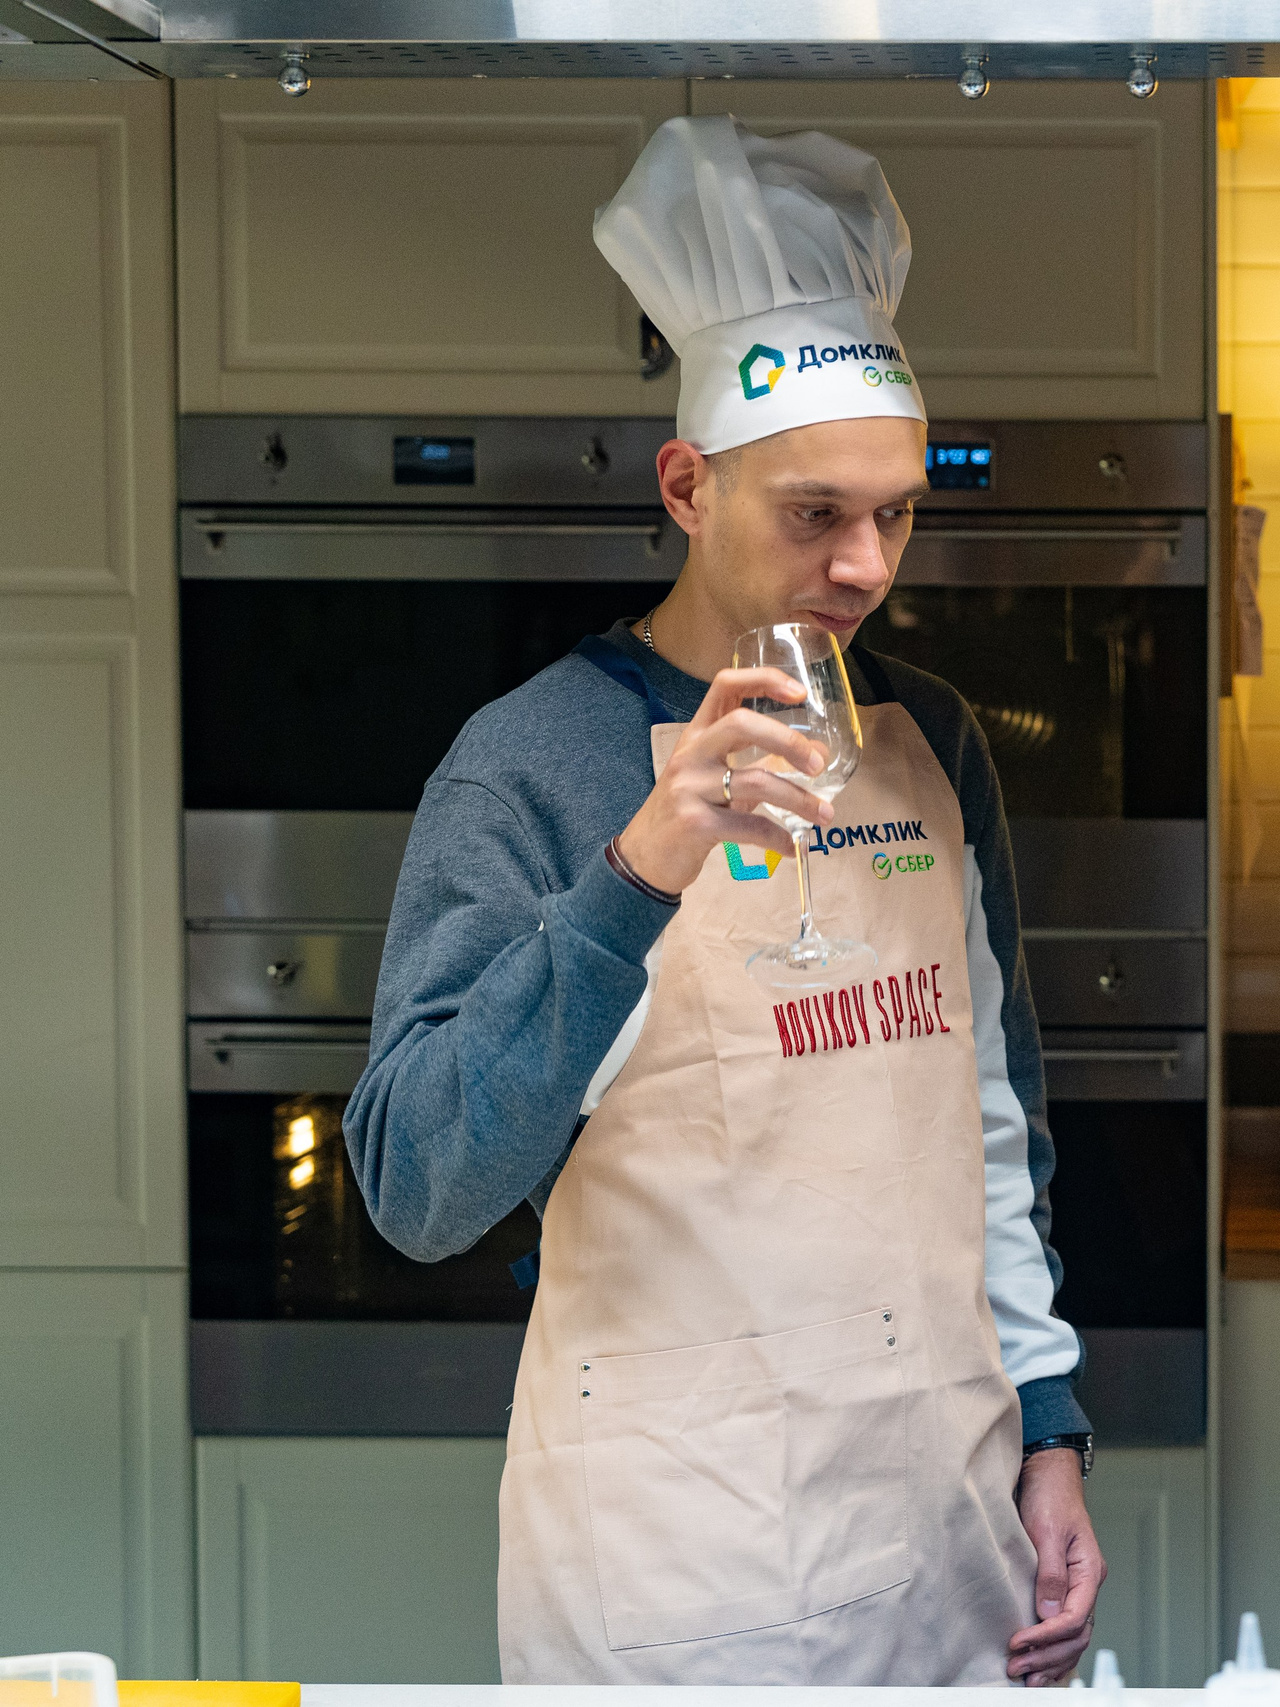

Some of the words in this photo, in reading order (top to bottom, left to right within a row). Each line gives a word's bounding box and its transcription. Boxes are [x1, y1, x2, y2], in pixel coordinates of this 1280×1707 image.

[885, 370, 912, 386] СБЕР
[895, 854, 935, 873] СБЕР
[773, 984, 870, 1058] NOVIKOV
[873, 963, 950, 1042] SPACE
